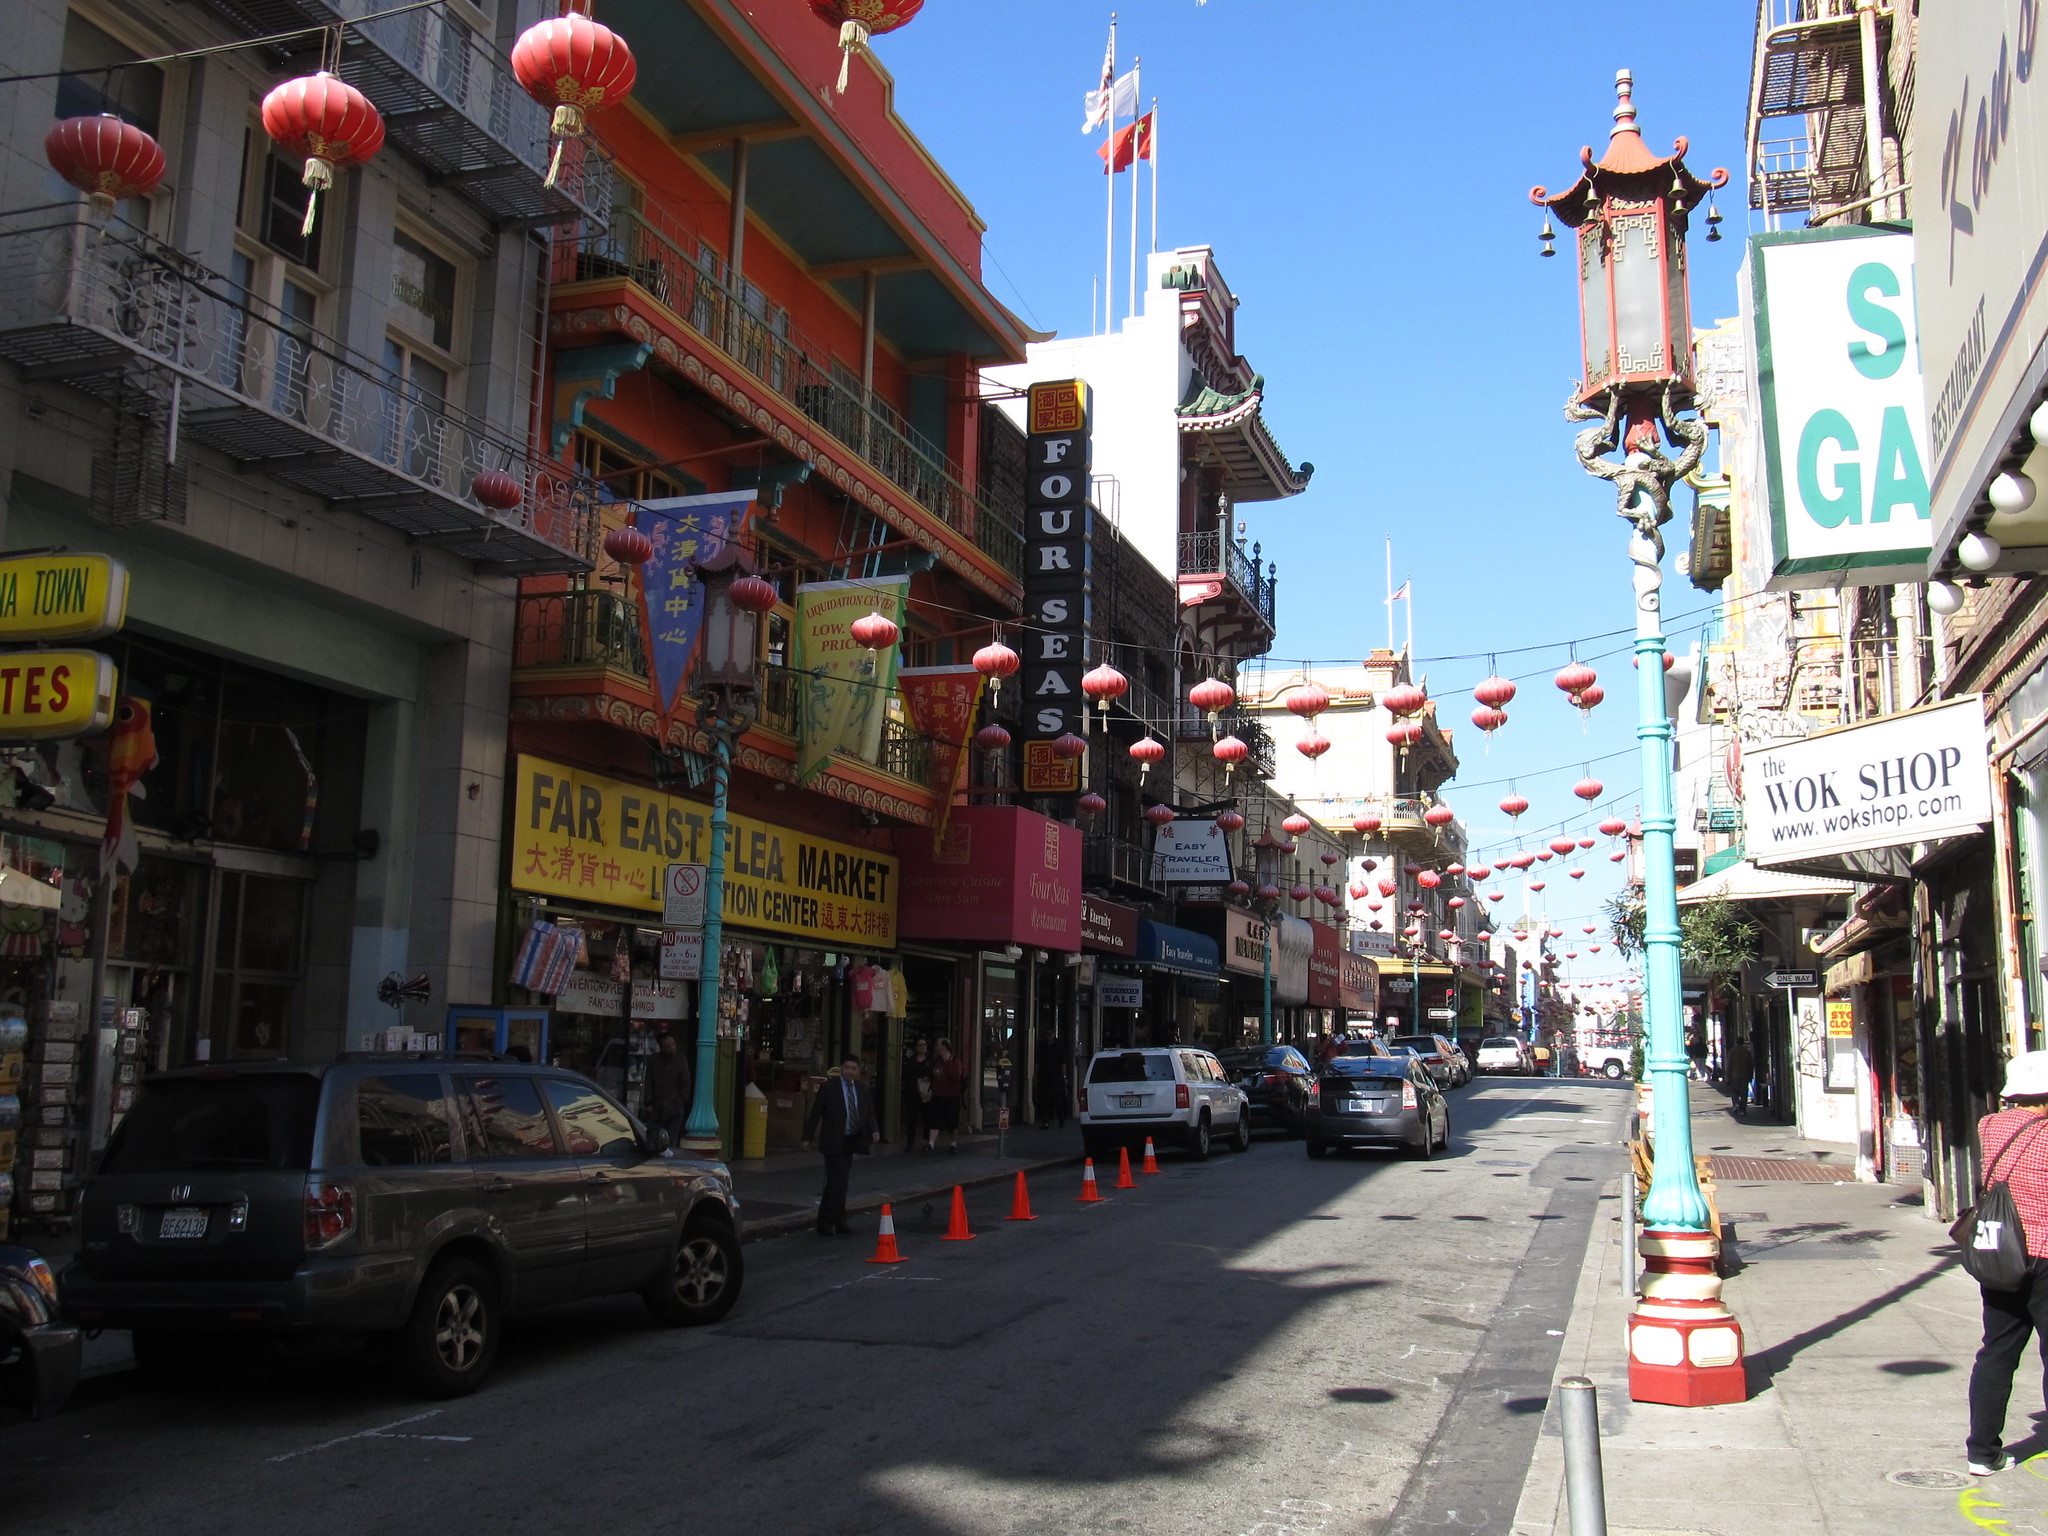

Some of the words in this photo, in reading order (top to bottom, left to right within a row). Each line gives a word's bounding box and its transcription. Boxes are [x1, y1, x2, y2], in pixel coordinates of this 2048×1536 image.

[1846, 262, 1921, 380] S
[1931, 292, 1988, 464] RESTAURANT
[1038, 438, 1073, 572] FOUR
[34, 567, 89, 616] TOWN
[806, 594, 862, 619] LIQUIDATION
[863, 595, 896, 611] CENTER
[1035, 598, 1071, 734] SEAS
[1763, 755, 1786, 778] the
[1765, 770, 1842, 817] WOK
[1858, 746, 1962, 801] SHOP
[531, 771, 604, 844] FAR
[620, 794, 705, 864] EAST
[710, 815, 785, 883] FLEA
[798, 843, 890, 904] MARKET
[1175, 843, 1207, 851] EASY
[962, 874, 1004, 888] Cuisine
[1029, 872, 1051, 900] Four
[1051, 877, 1071, 905] Seas
[762, 890, 819, 929] CENTER
[927, 892, 952, 904] Dim
[953, 892, 980, 905] Sum
[1030, 907, 1068, 932] Restaurant
[1089, 908, 1112, 930] Eternity
[662, 931, 675, 946] NO
[676, 934, 701, 945] PARKING
[1777, 974, 1793, 982] ONE
[1794, 974, 1811, 982] WAY
[631, 1002, 655, 1012] AVINGS
[1104, 995, 1137, 1003] SALE
